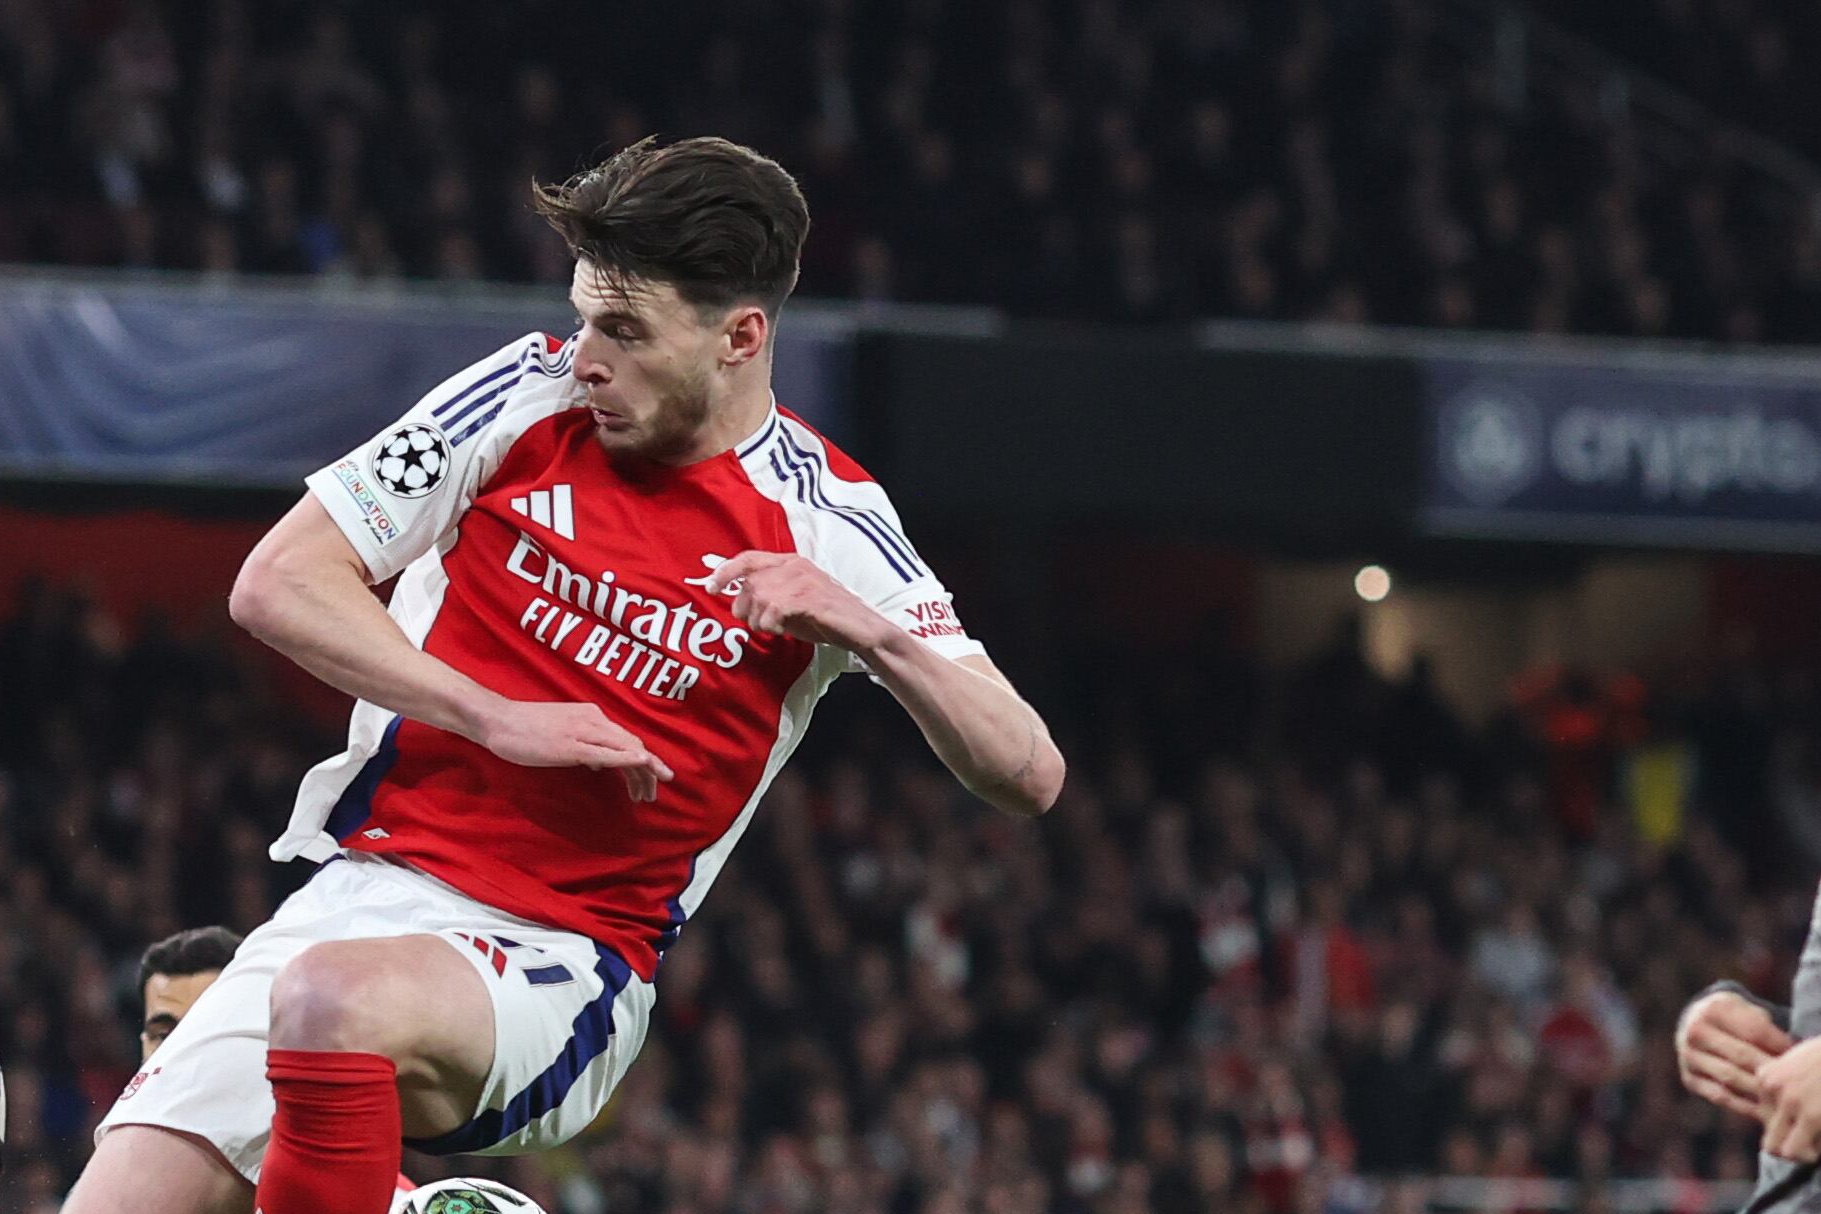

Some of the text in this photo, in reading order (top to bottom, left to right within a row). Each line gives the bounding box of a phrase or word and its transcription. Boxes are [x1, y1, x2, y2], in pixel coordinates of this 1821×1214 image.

[336, 462, 397, 540] FOUNDATION
[506, 530, 749, 668] Emirates
[519, 597, 701, 700] FLY BETTER
